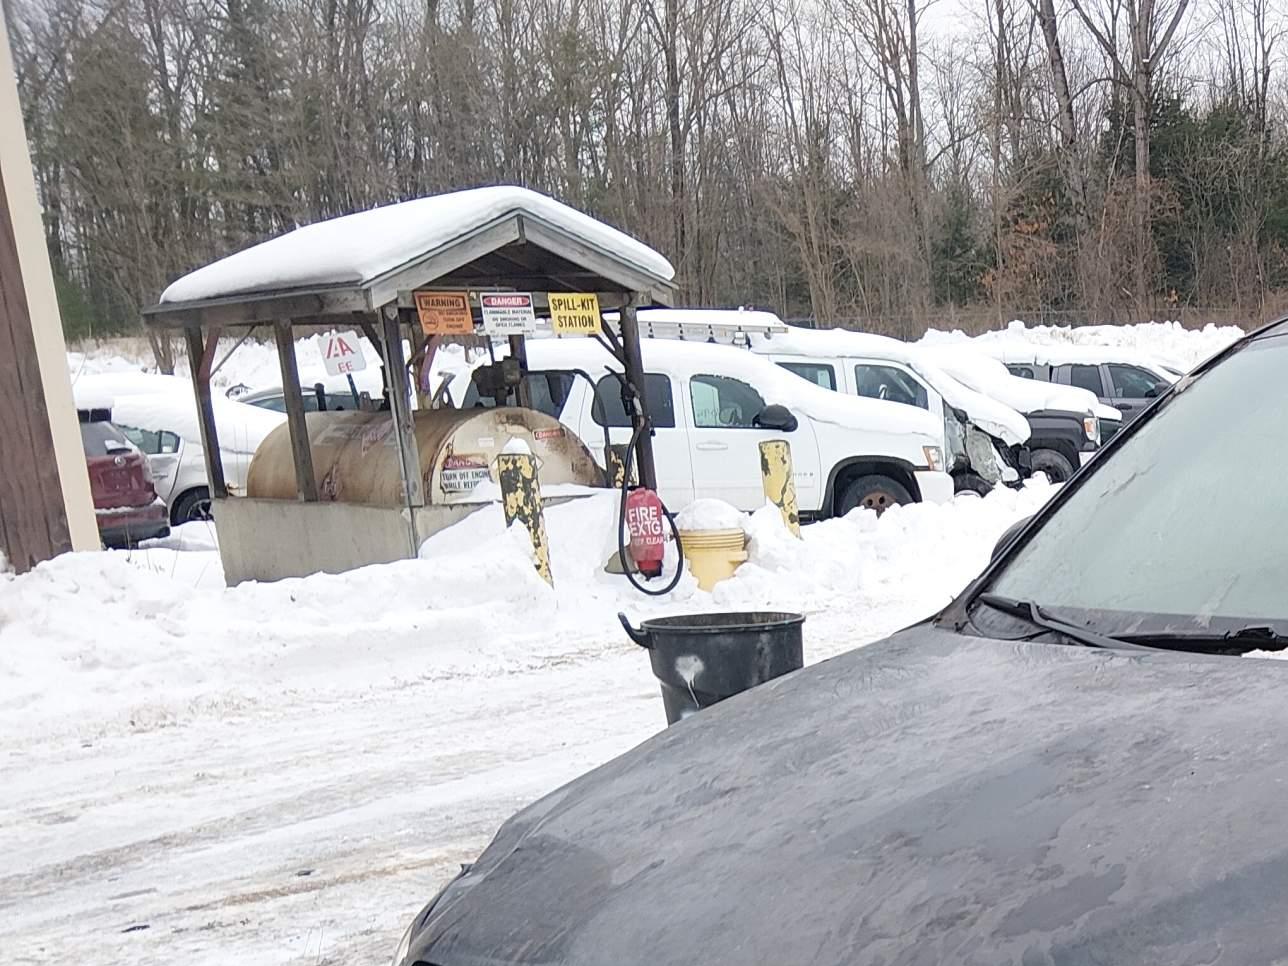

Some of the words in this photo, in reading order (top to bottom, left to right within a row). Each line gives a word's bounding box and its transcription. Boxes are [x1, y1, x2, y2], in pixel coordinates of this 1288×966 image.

[424, 297, 461, 307] WARNING
[491, 296, 523, 306] DANGER
[551, 297, 595, 311] SPILL-KIT
[557, 314, 595, 328] STATION
[628, 506, 658, 522] FIRE
